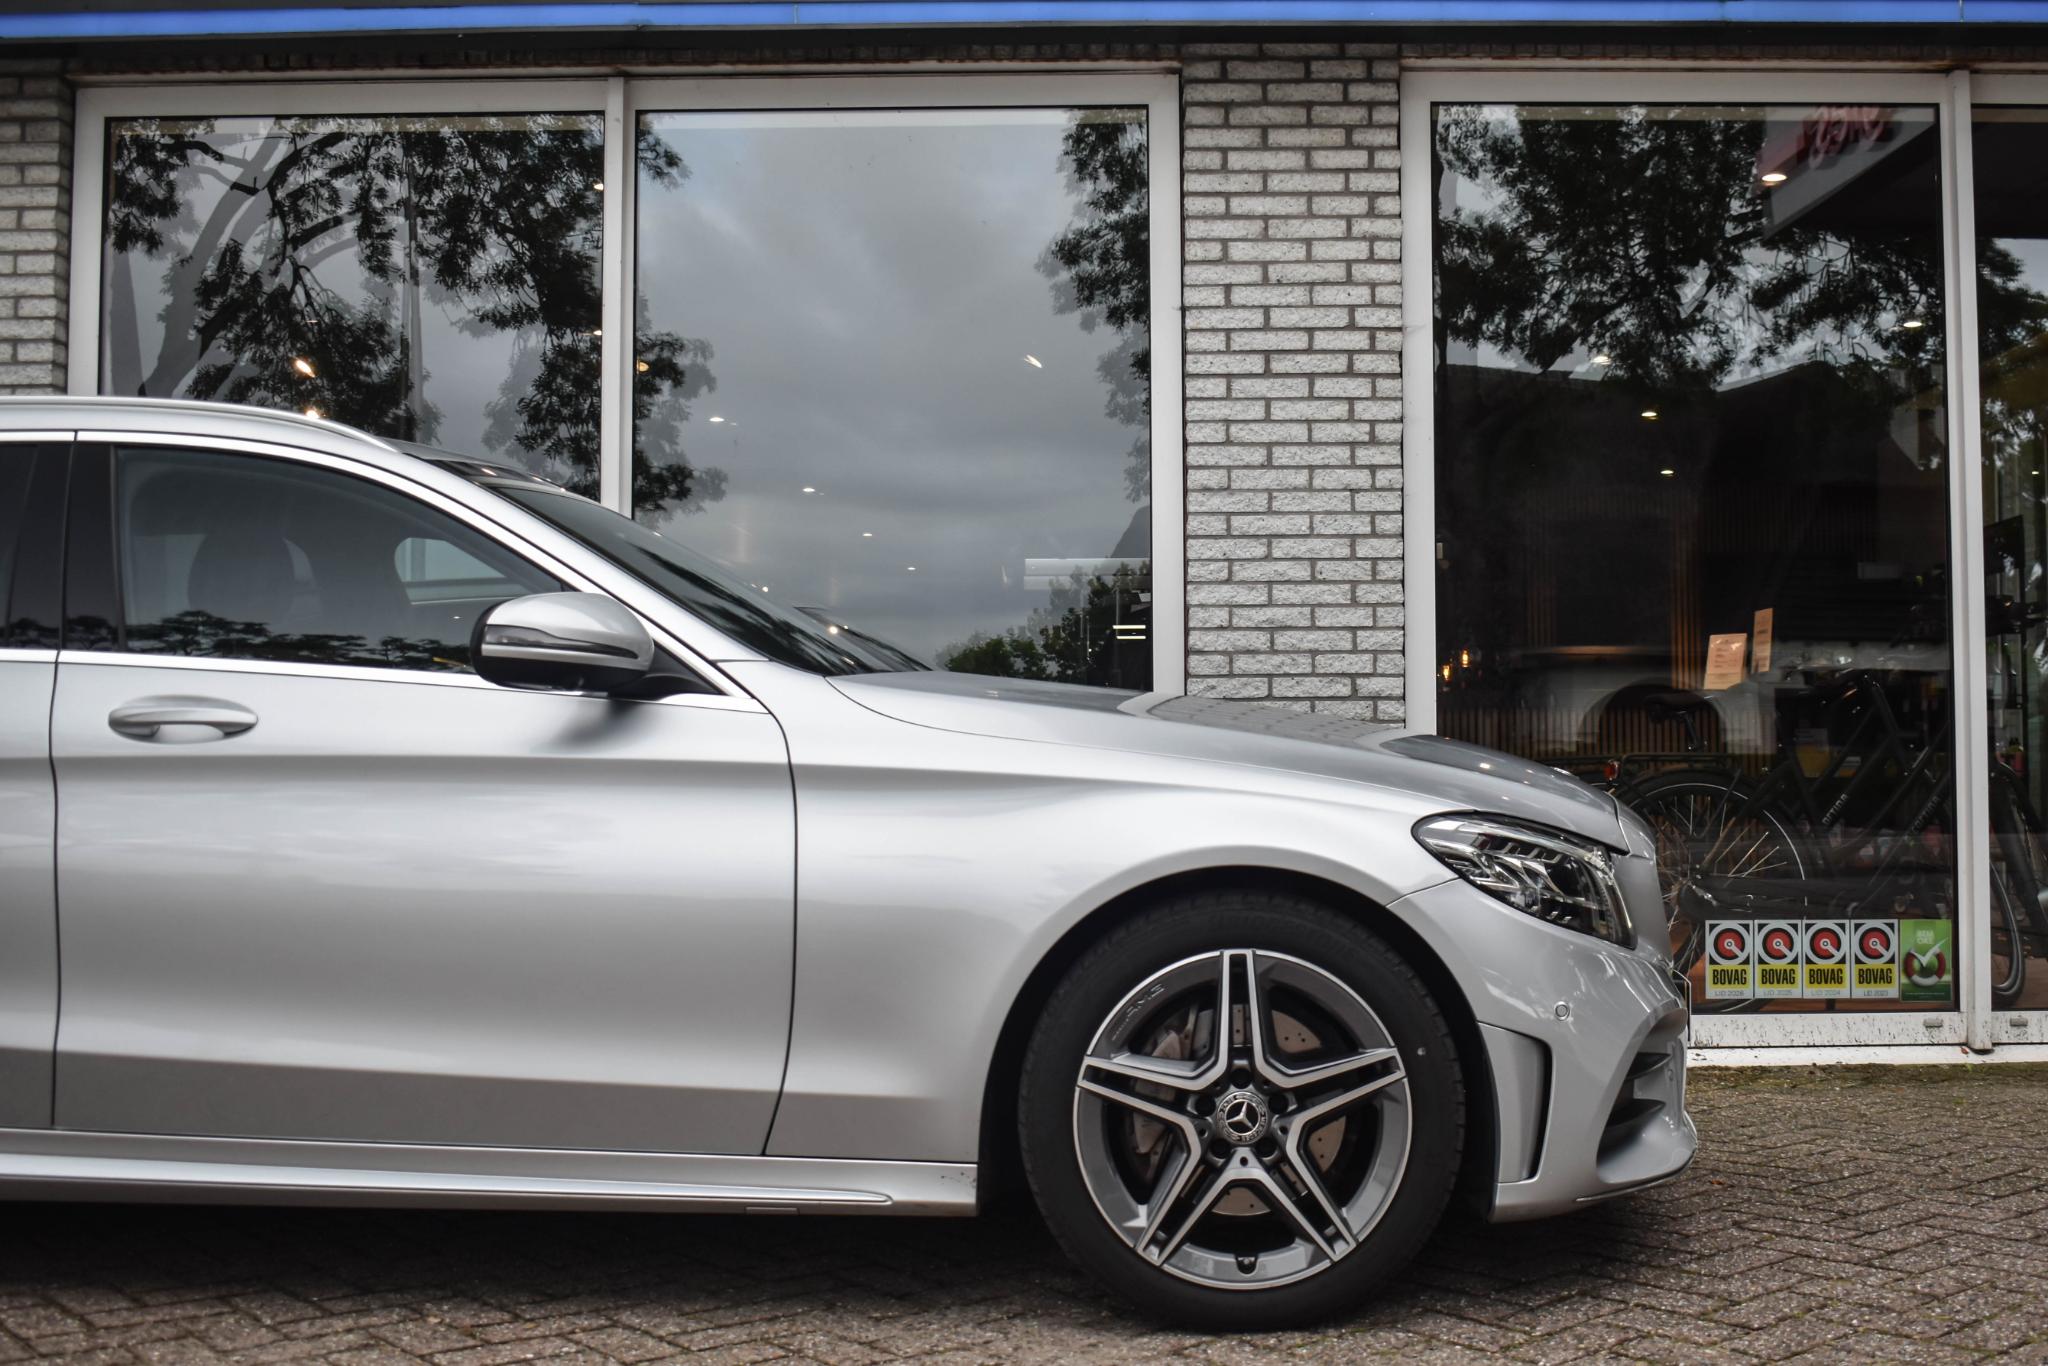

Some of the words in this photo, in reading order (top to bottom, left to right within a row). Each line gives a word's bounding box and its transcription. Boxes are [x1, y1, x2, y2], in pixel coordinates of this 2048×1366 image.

[1712, 968, 1748, 985] BOVAG
[1762, 968, 1797, 985] BOVAG
[1809, 968, 1844, 985] BOVAG
[1858, 967, 1894, 984] BOVAG
